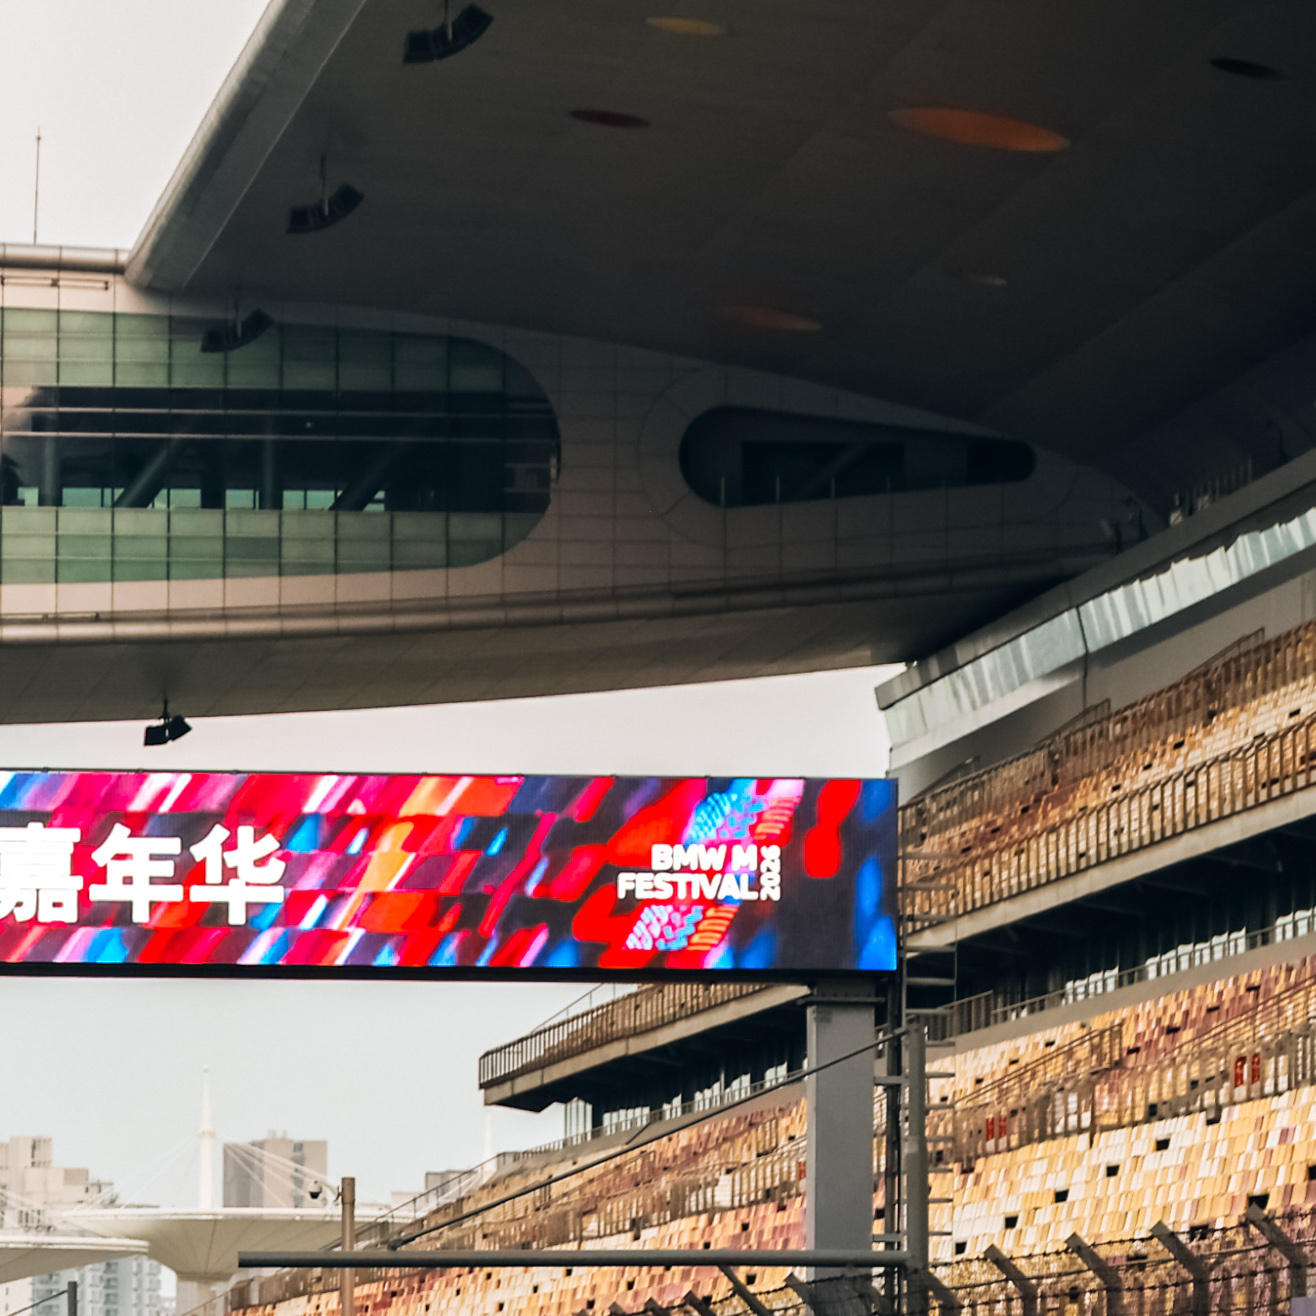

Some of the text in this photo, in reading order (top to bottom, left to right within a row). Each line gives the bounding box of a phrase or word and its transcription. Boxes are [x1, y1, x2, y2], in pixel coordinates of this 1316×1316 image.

[651, 844, 758, 871] BMW M
[617, 872, 759, 900] FESTIVAL
[759, 845, 781, 901] 2026
